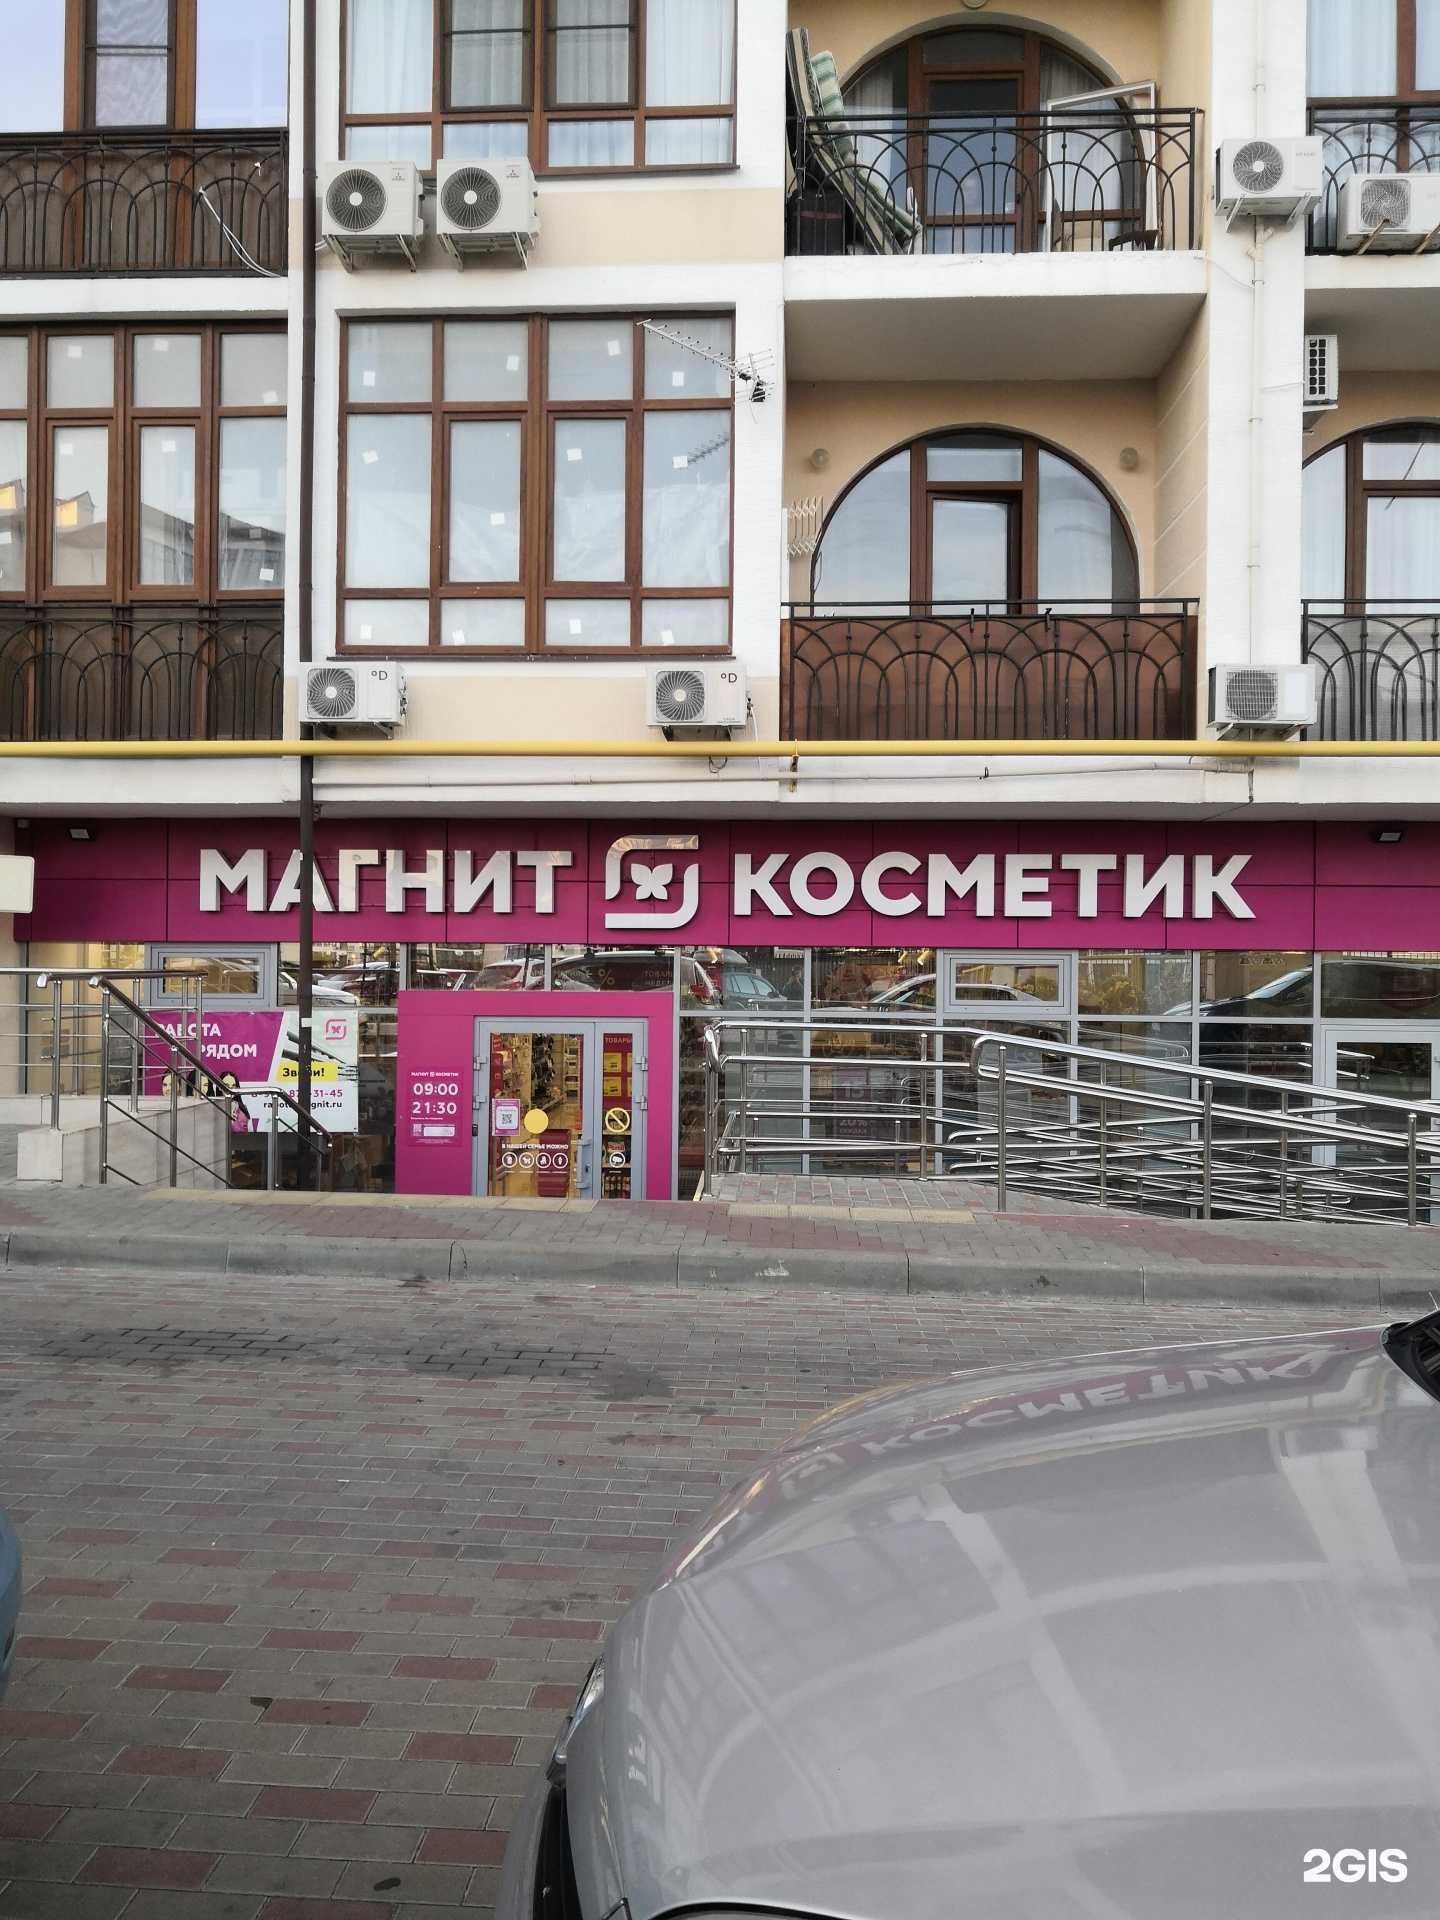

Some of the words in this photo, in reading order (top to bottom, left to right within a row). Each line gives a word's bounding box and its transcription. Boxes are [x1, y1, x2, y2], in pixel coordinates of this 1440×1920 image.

[199, 848, 574, 914] МАГНИТ
[733, 851, 1256, 918] КОСМЕТИК
[282, 1067, 325, 1077] Зви!
[413, 1083, 459, 1096] 09:00
[412, 1101, 457, 1115] 21:30
